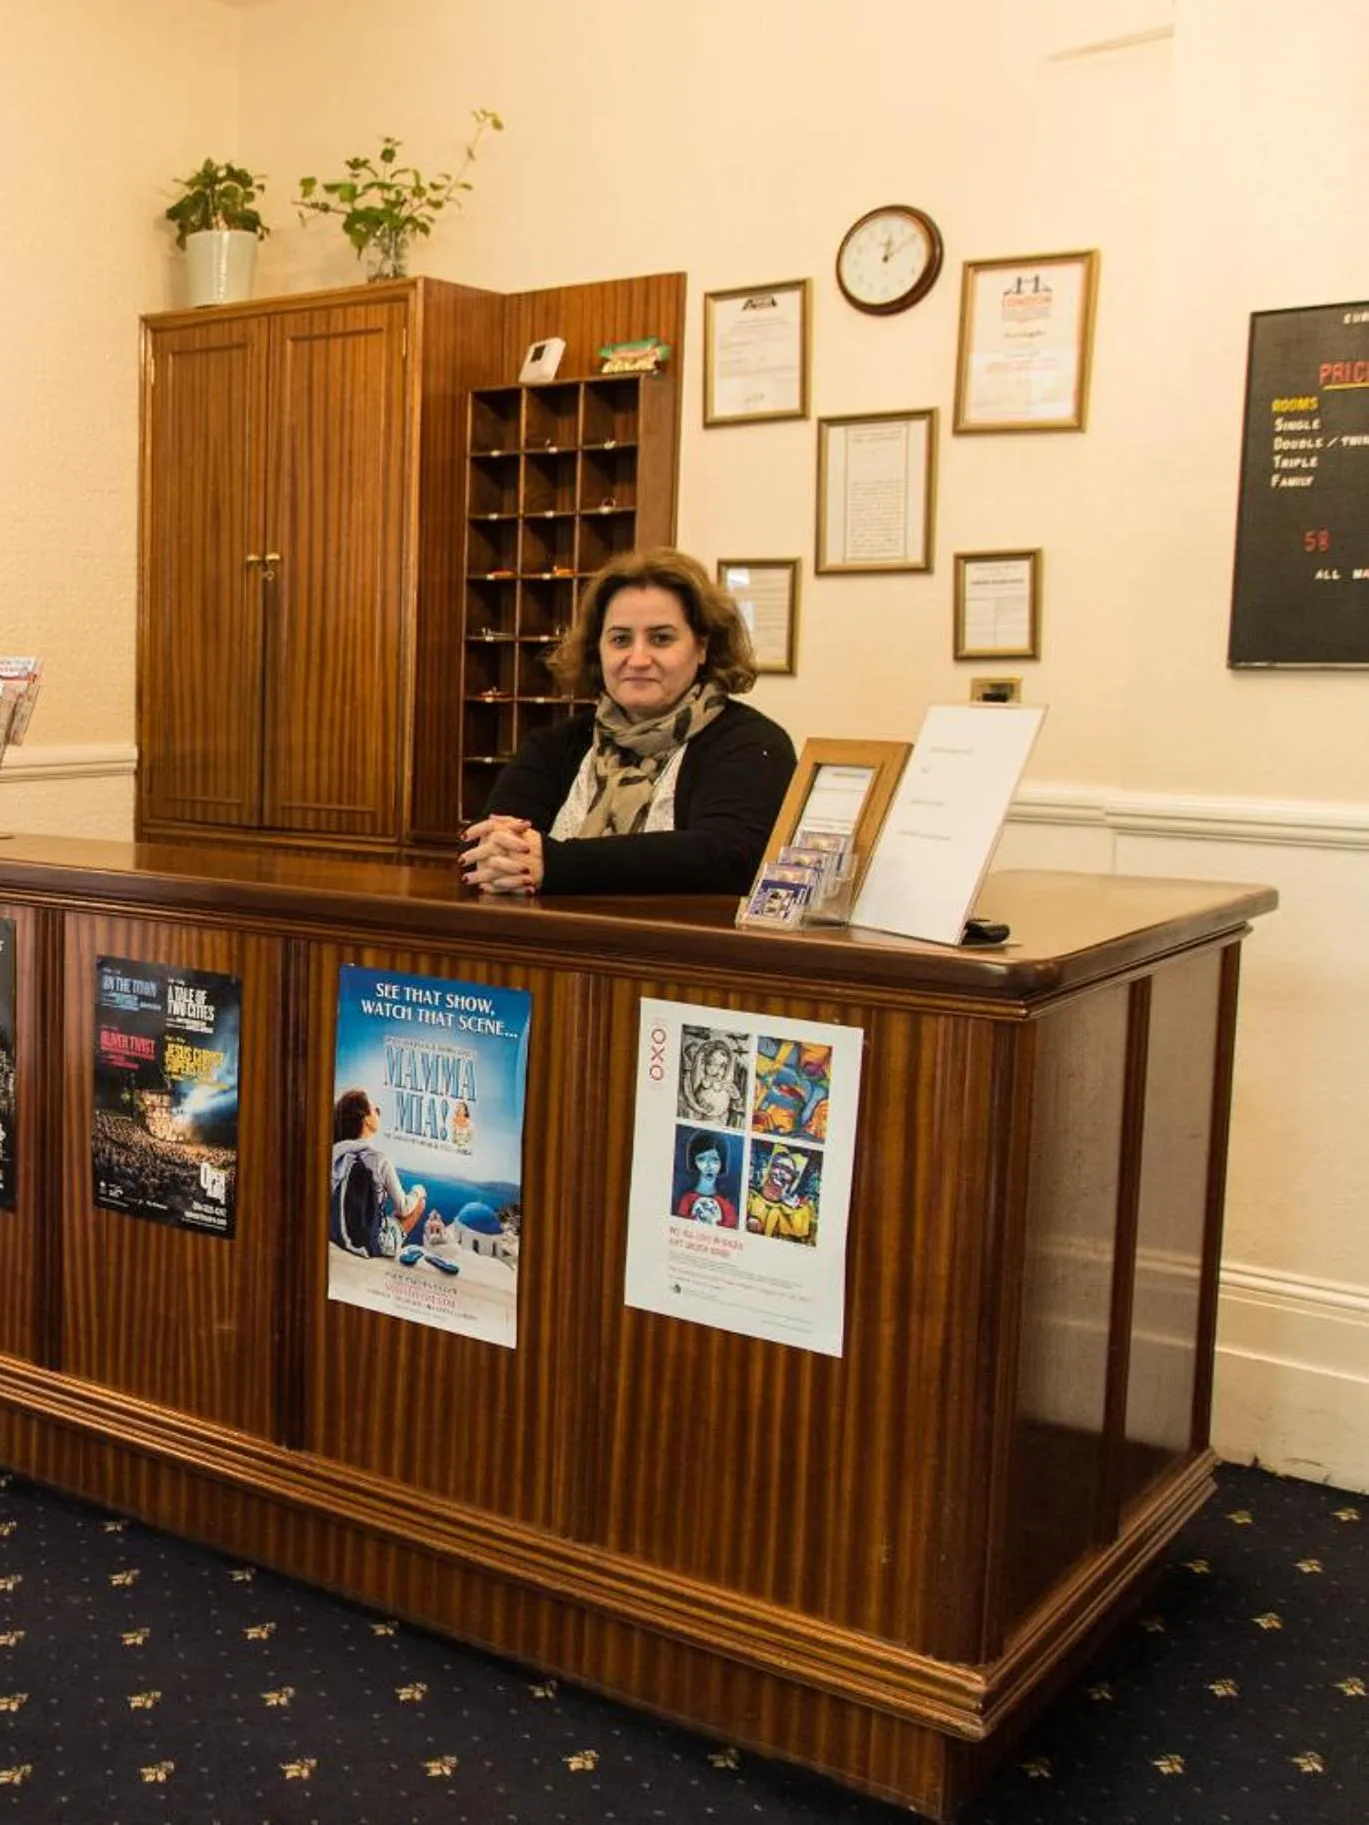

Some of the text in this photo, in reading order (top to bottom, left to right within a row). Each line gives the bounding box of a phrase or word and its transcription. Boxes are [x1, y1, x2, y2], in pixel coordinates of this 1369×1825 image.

[1319, 360, 1369, 385] PRIC
[1315, 568, 1341, 580] ALL
[375, 983, 401, 999] SEE
[403, 986, 442, 1006] THAT
[187, 1003, 216, 1022] CITIES
[361, 999, 413, 1021] WATCH
[417, 1008, 455, 1028] THAT
[649, 1028, 667, 1081] OXO
[383, 1044, 477, 1102] MAMMA
[393, 1091, 448, 1141] MIA!
